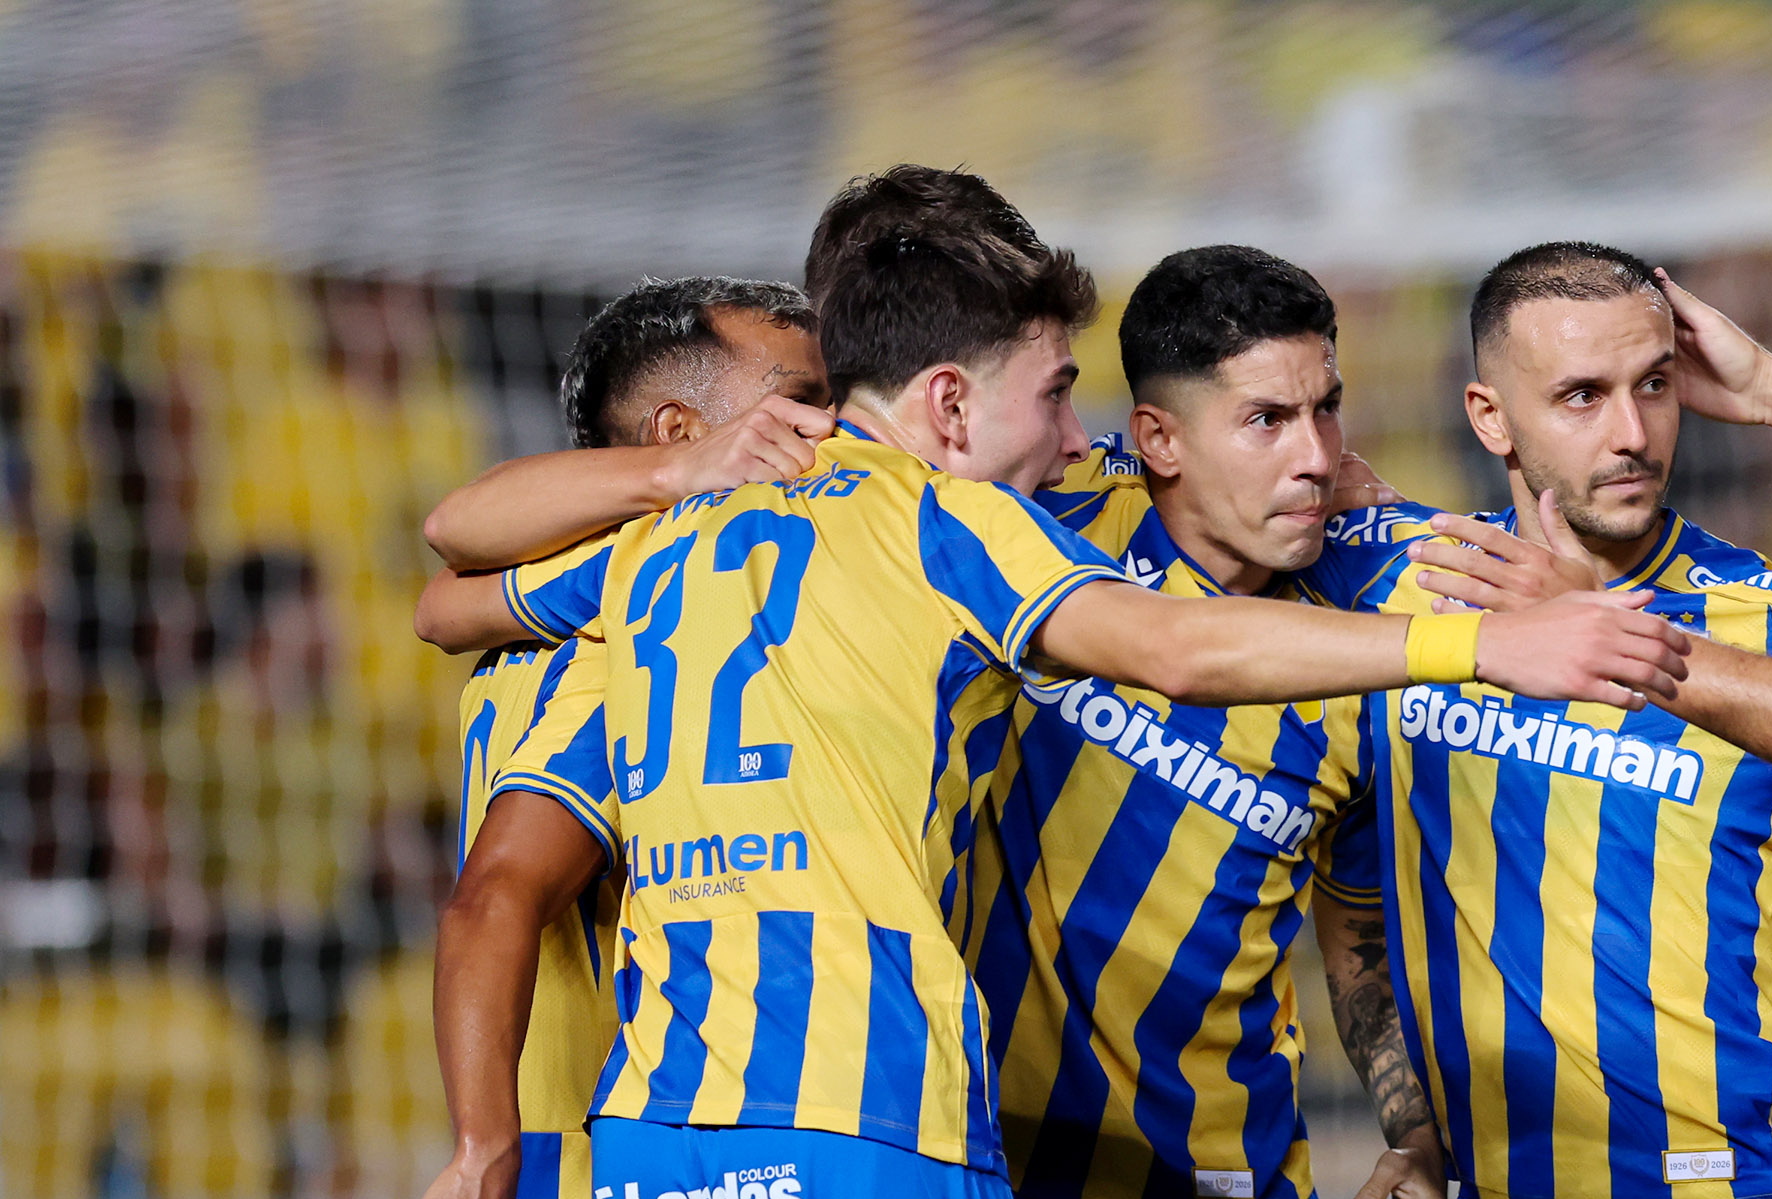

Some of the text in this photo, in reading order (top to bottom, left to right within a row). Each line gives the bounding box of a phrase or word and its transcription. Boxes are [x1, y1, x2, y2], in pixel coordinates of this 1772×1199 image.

[613, 508, 817, 806] 32
[1400, 684, 1700, 800] Stoiximan
[738, 751, 762, 772] 100
[632, 830, 808, 890] Lumen
[669, 876, 747, 904] INSURANCE
[738, 1163, 797, 1185] COLOUR
[1711, 1159, 1731, 1169] 2026
